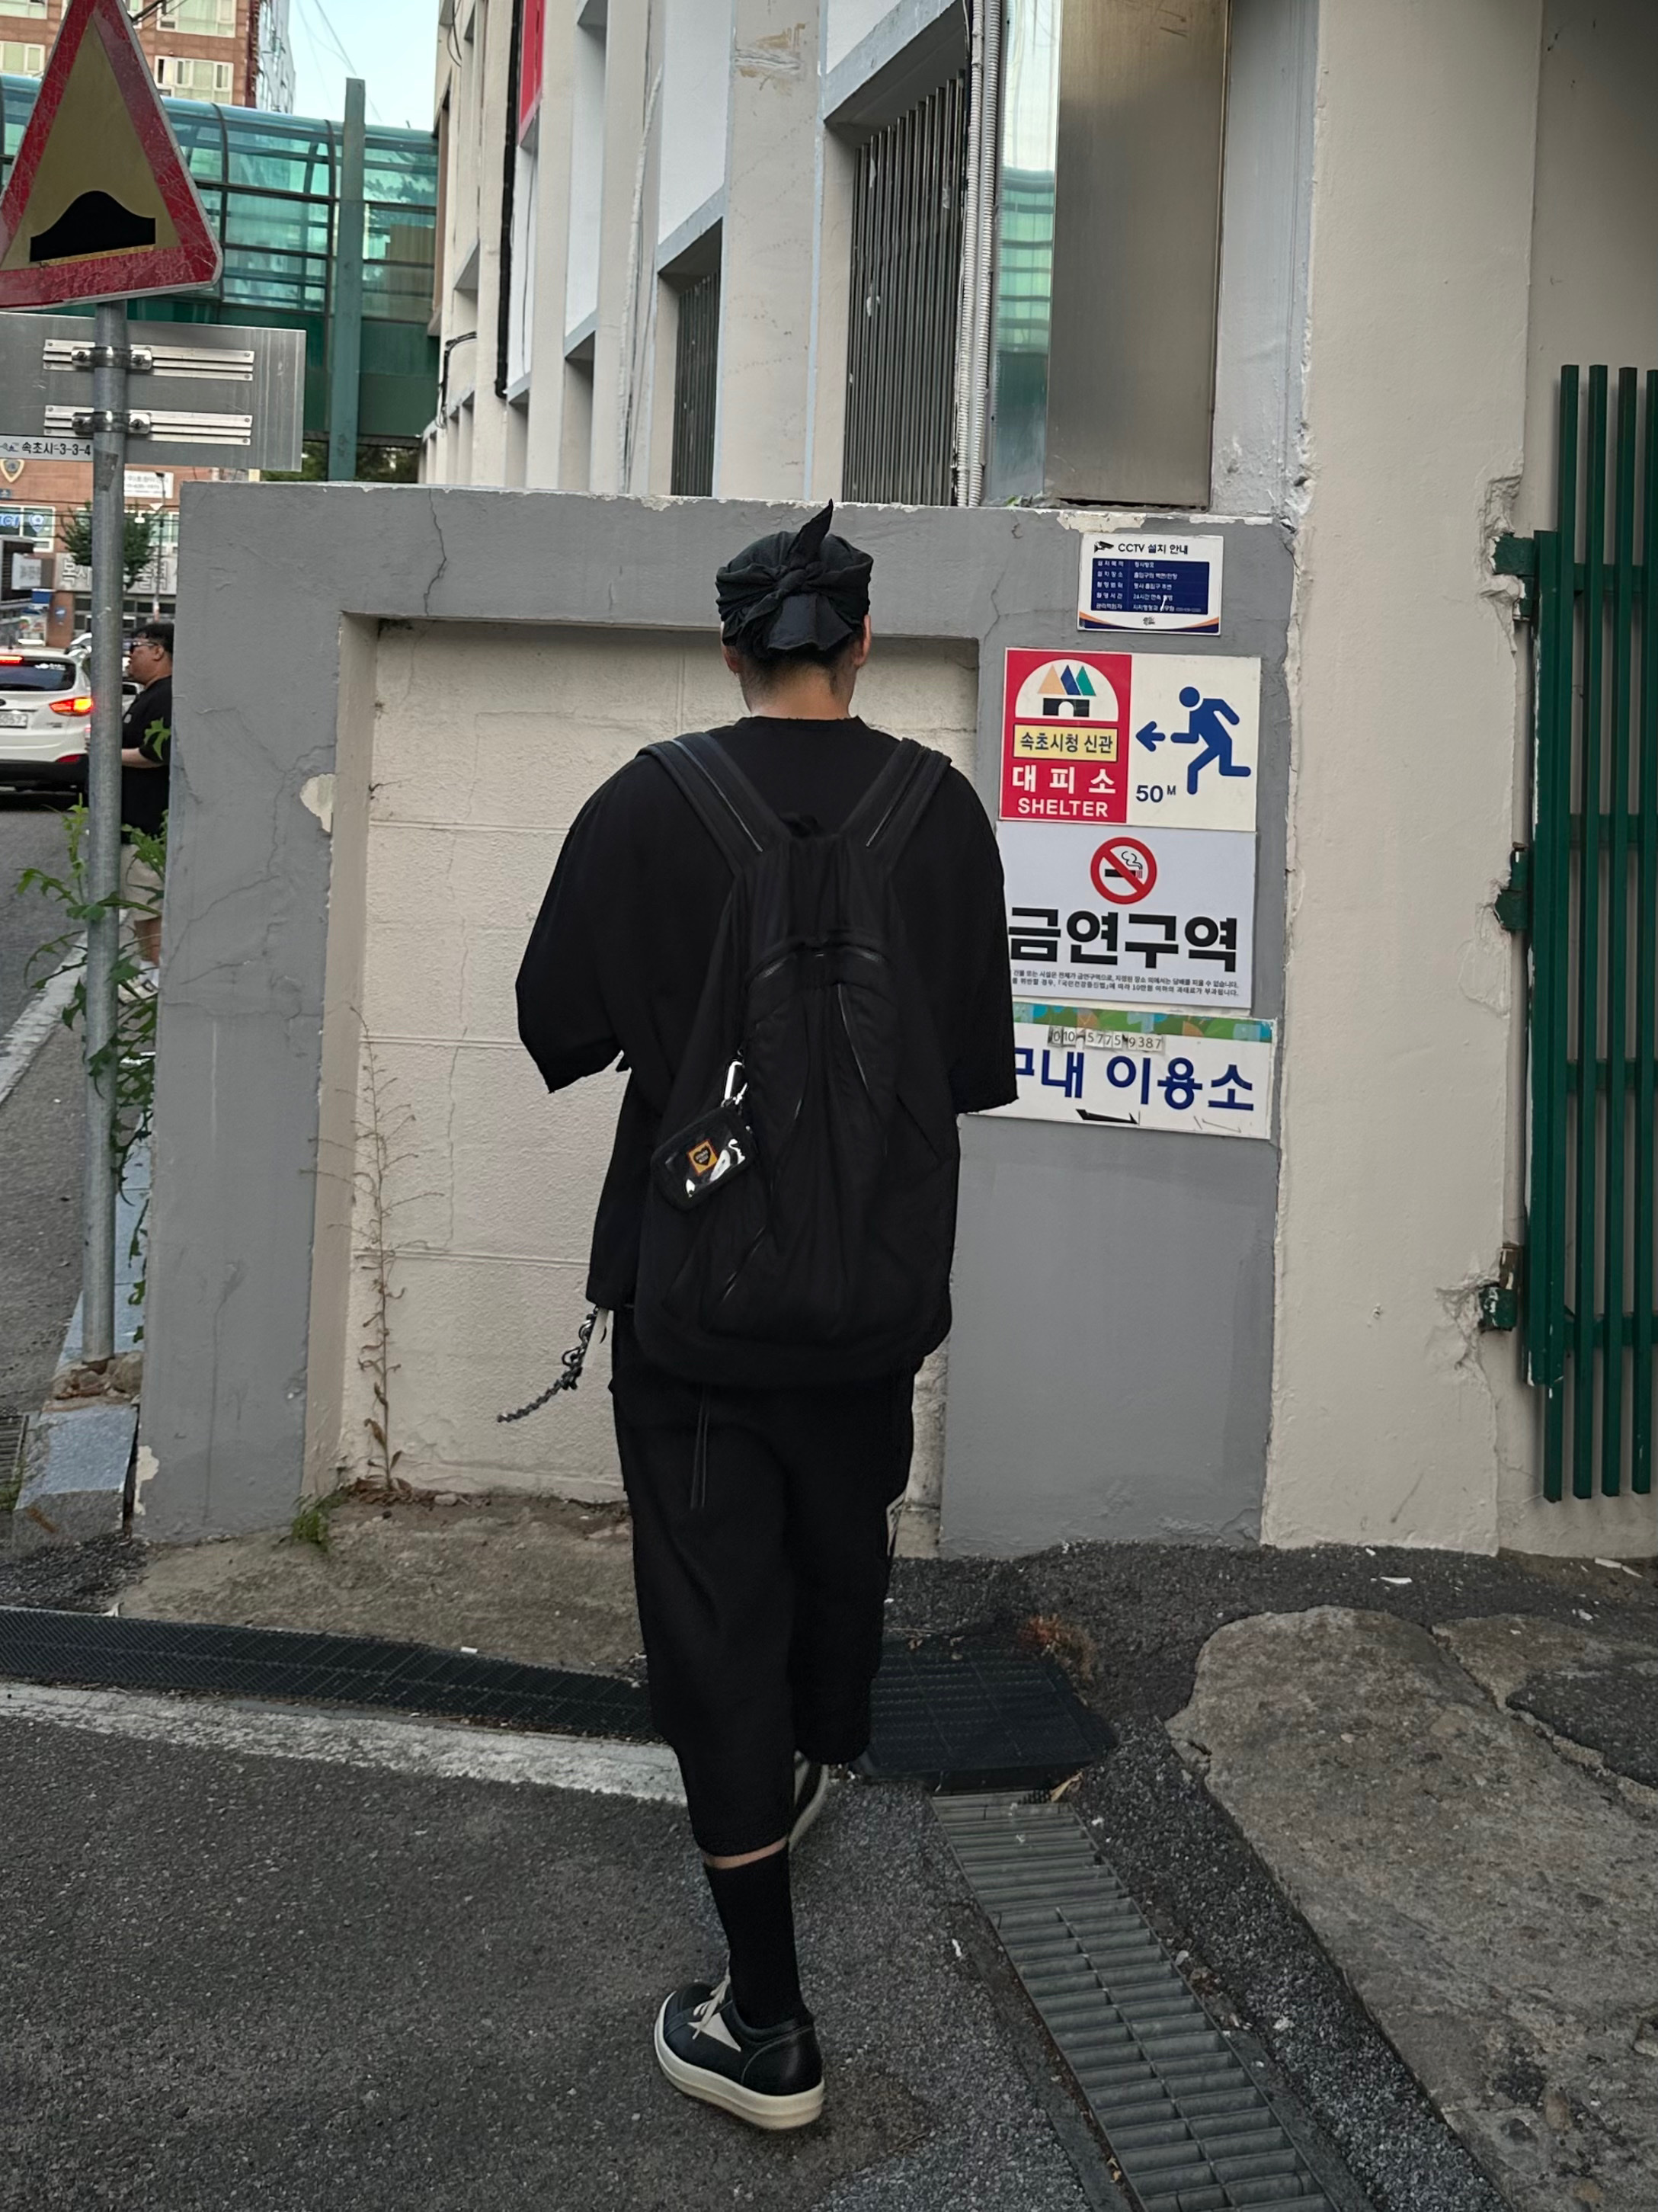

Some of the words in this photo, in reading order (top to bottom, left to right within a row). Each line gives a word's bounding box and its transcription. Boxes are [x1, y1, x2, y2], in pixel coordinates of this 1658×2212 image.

[1118, 543, 1145, 552] CCTV
[1170, 544, 1189, 555] 안내
[1020, 731, 1078, 753] 속초시청
[1083, 734, 1113, 754] 신관
[1017, 797, 1109, 818] SHELTER
[1009, 907, 1237, 972] 금연구역
[1106, 1055, 1254, 1111] 이용소
